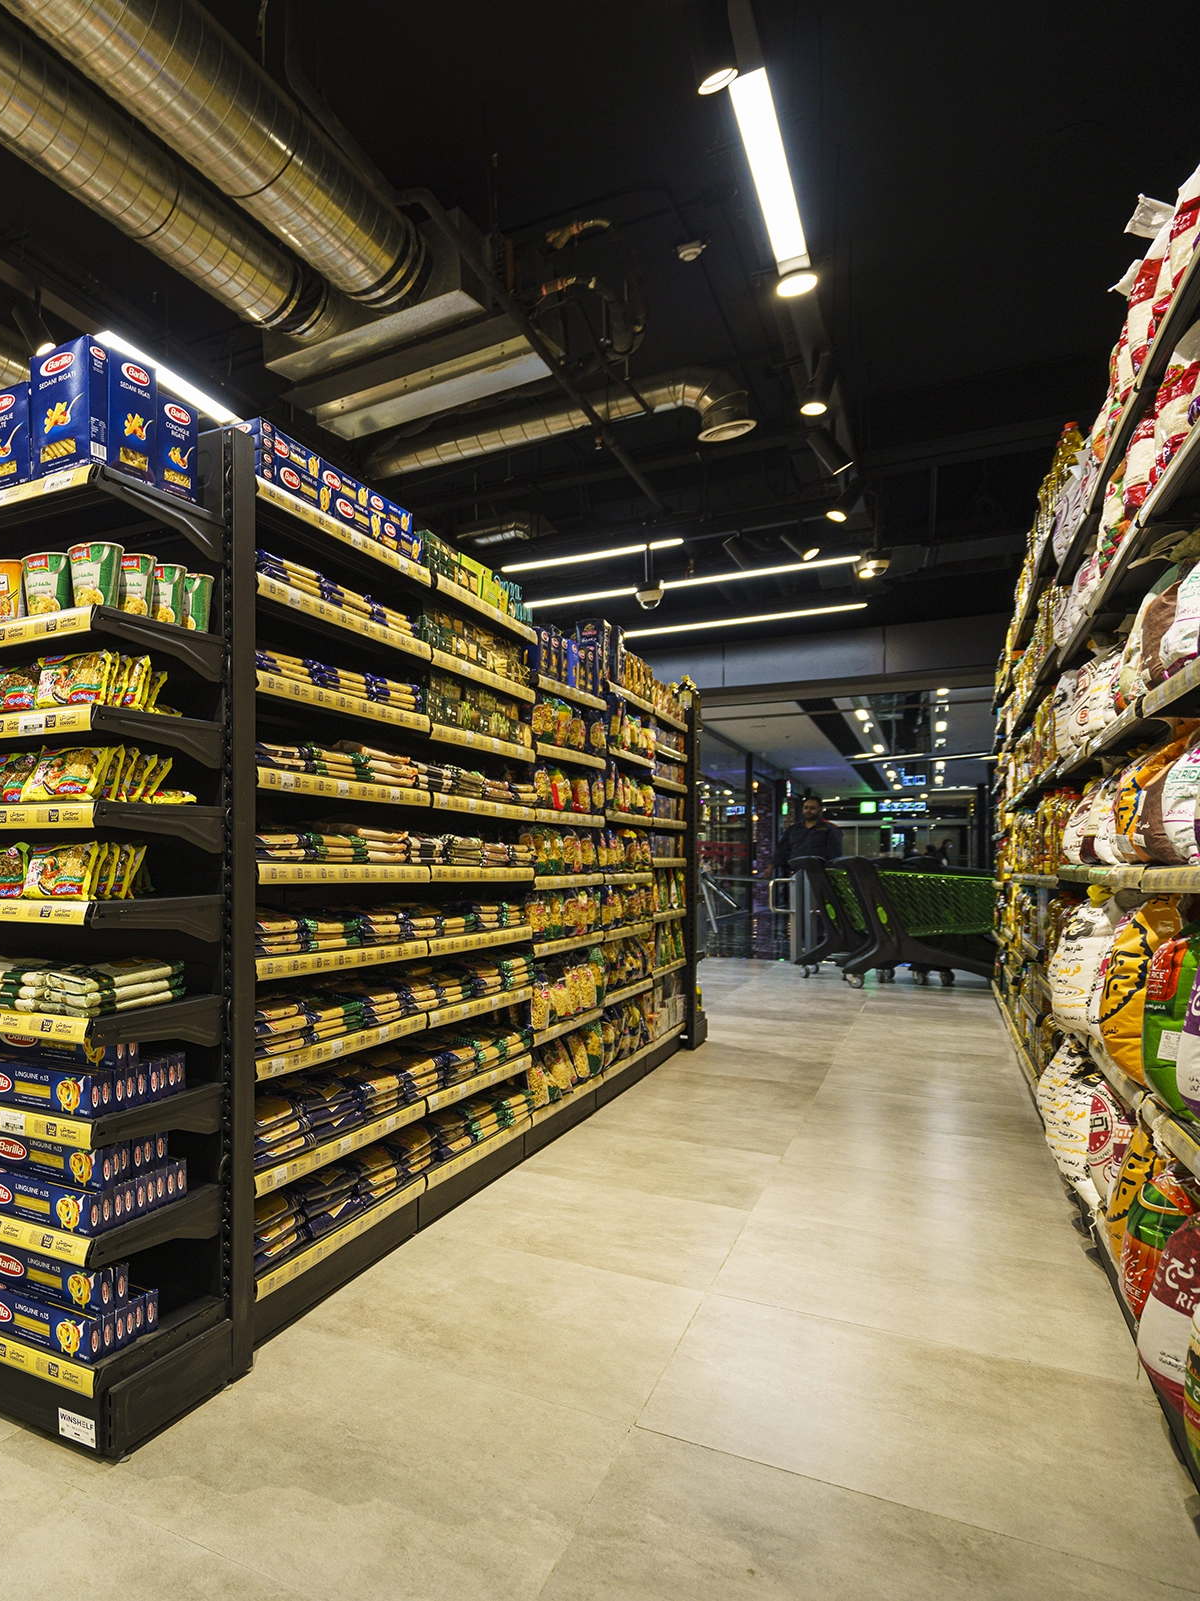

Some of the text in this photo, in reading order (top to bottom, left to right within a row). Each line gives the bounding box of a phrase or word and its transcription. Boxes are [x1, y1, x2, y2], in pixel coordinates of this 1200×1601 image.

[47, 355, 72, 371] Barilla
[38, 370, 77, 390] SEDANI RIGATI
[128, 368, 148, 383] Barilla
[120, 380, 137, 393] SEDANI
[170, 408, 189, 422] Barilla
[15, 1070, 38, 1080] LINGUINE
[29, 1139, 51, 1149] LINGUINE
[15, 1183, 39, 1195] LINGUINE
[27, 1257, 50, 1270] LINGUINE
[14, 1303, 38, 1316] LINGUINE
